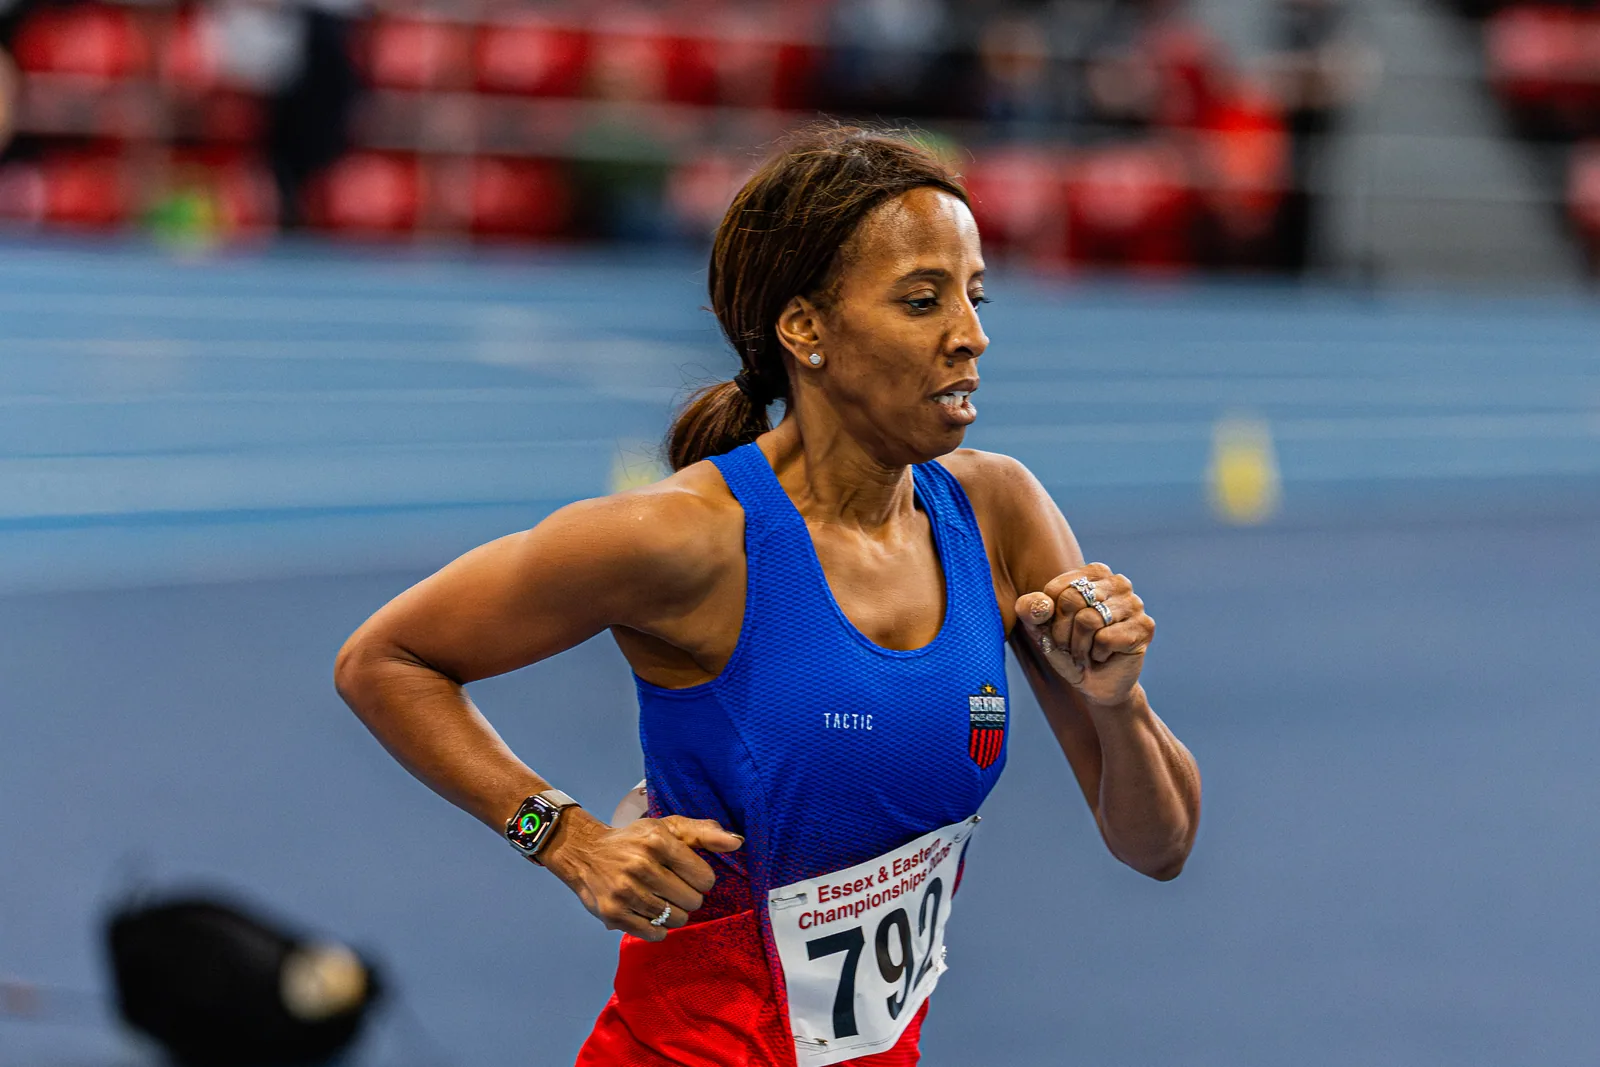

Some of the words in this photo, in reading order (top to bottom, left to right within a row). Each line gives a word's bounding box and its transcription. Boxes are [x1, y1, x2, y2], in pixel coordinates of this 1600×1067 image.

[823, 712, 873, 730] TACTIC
[798, 868, 927, 930] Championships
[818, 874, 874, 904] Essex
[877, 866, 889, 884] &
[806, 876, 943, 1039] 792
